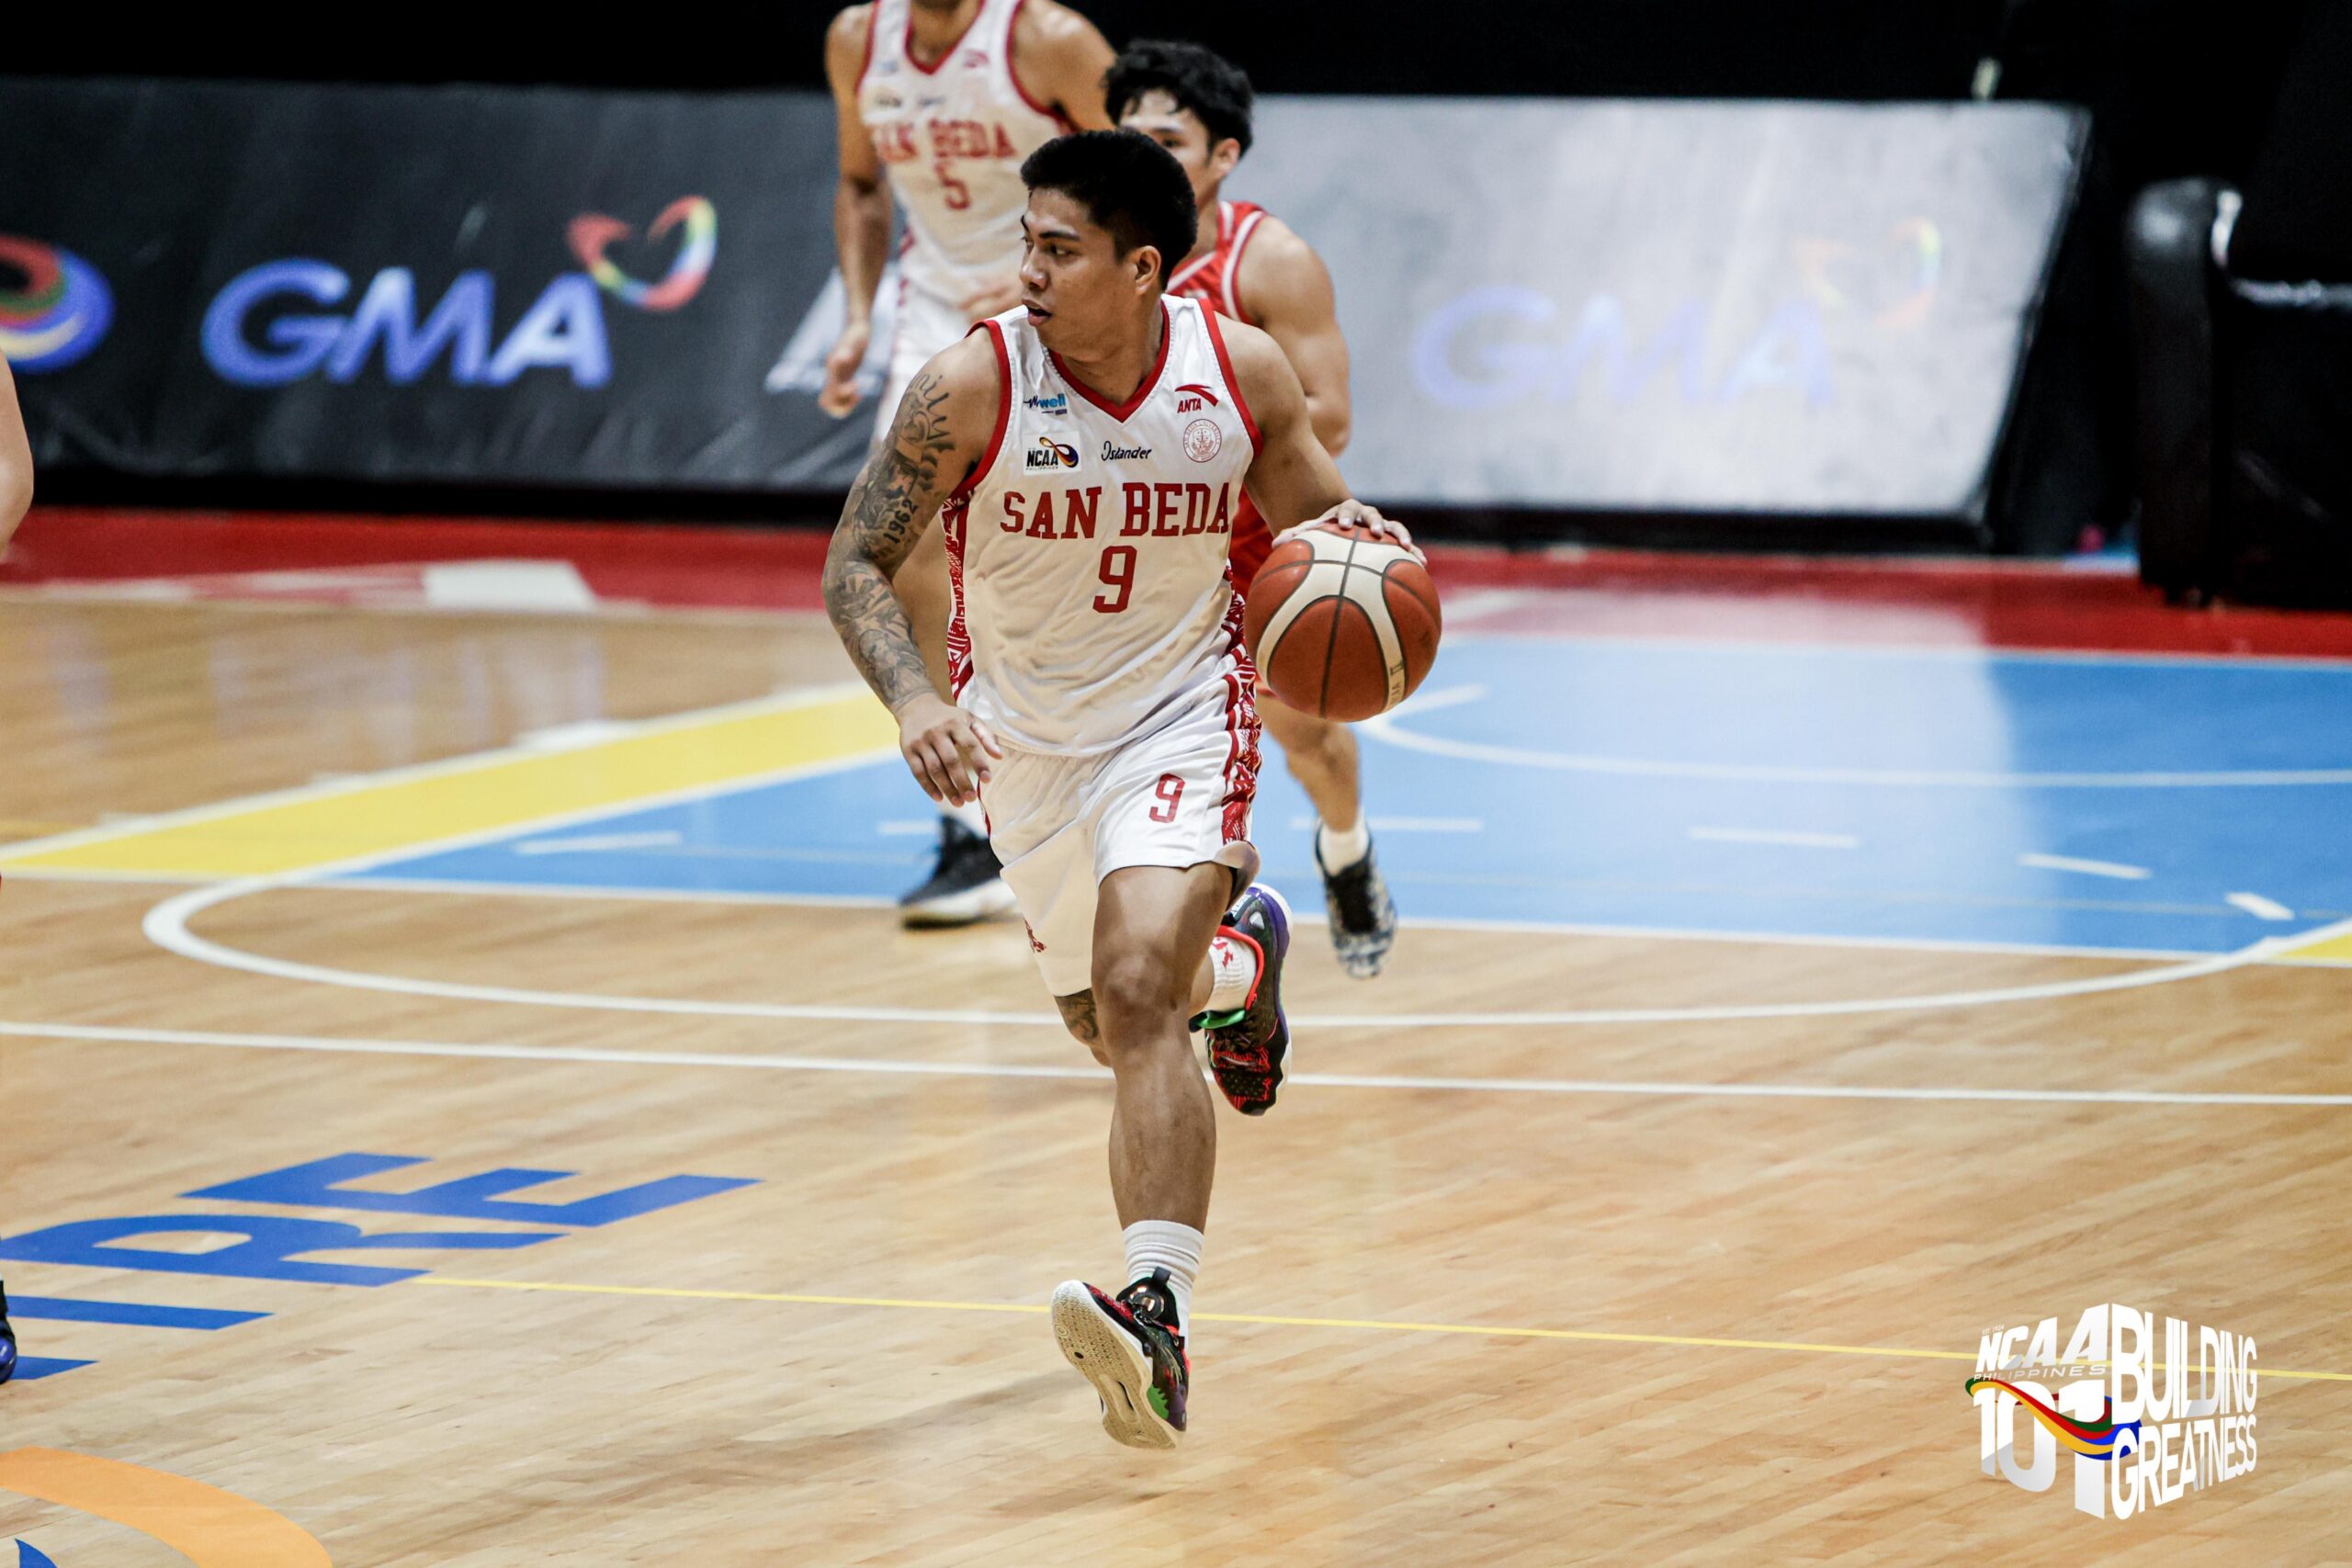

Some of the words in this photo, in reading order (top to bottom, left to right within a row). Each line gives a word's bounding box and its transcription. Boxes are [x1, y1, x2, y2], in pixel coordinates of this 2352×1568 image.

[928, 119, 1016, 158] BEDA
[933, 160, 970, 210] 5
[200, 257, 612, 388] GMA
[1412, 285, 1838, 409] GMA
[1177, 398, 1202, 413] ANTA
[1026, 449, 1058, 467] NCAA
[1101, 440, 1152, 461] Islander
[883, 498, 918, 545] 1962
[1000, 486, 1102, 539] SAN
[1119, 482, 1230, 537] BEDA
[1092, 545, 1137, 614] 9
[1149, 773, 1184, 823] 9
